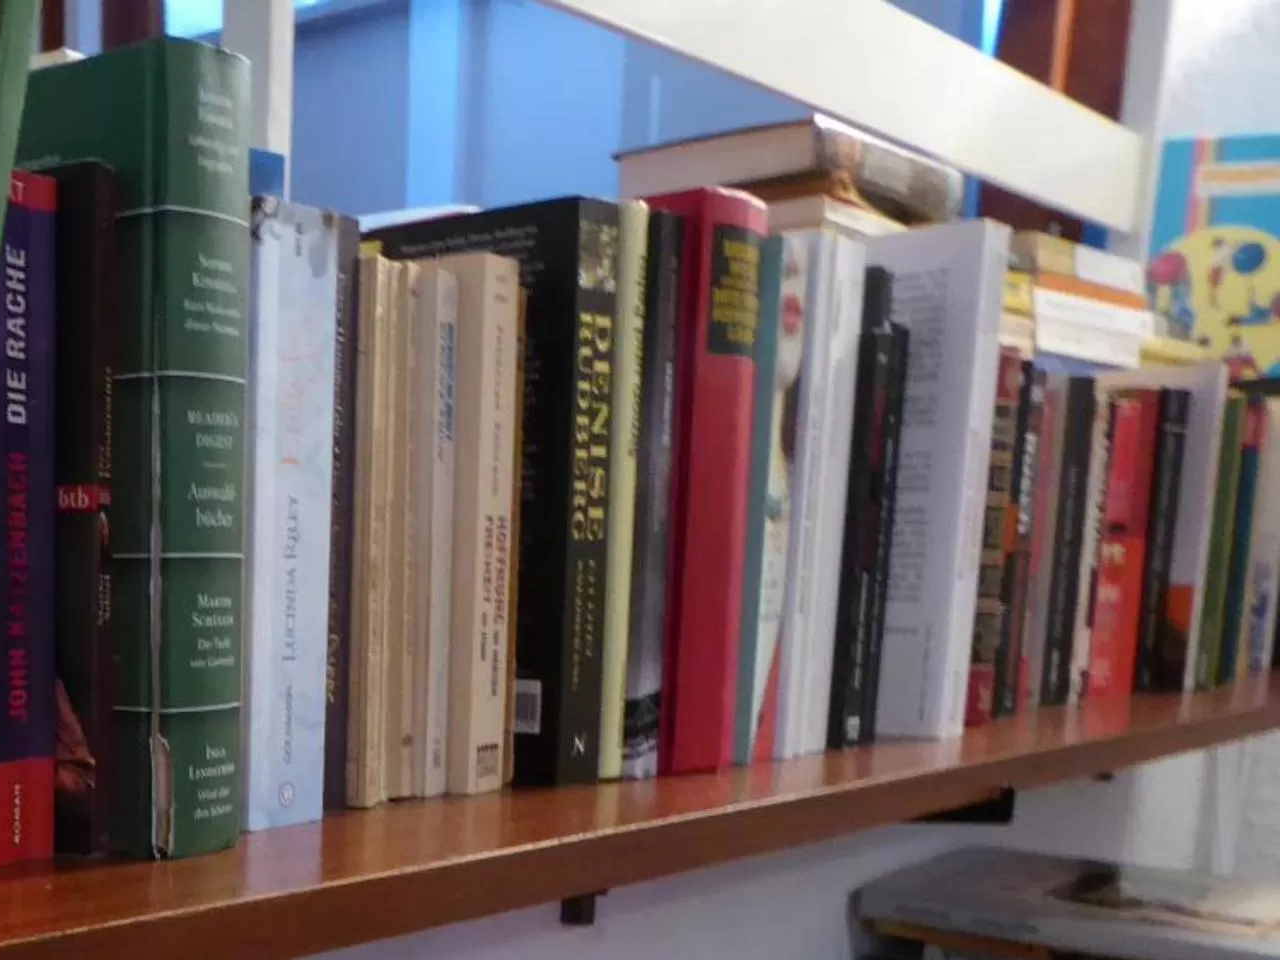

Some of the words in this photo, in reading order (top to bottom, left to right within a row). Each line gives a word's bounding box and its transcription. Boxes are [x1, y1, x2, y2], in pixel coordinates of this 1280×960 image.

[6, 244, 27, 360] RACHE
[6, 367, 27, 425] DIE
[571, 312, 594, 541] RUDBERG
[587, 314, 612, 541] DENISE
[58, 487, 90, 509] btb
[283, 494, 299, 561] RILEY
[282, 567, 298, 664] LUCINDA
[8, 649, 29, 722] JOHN
